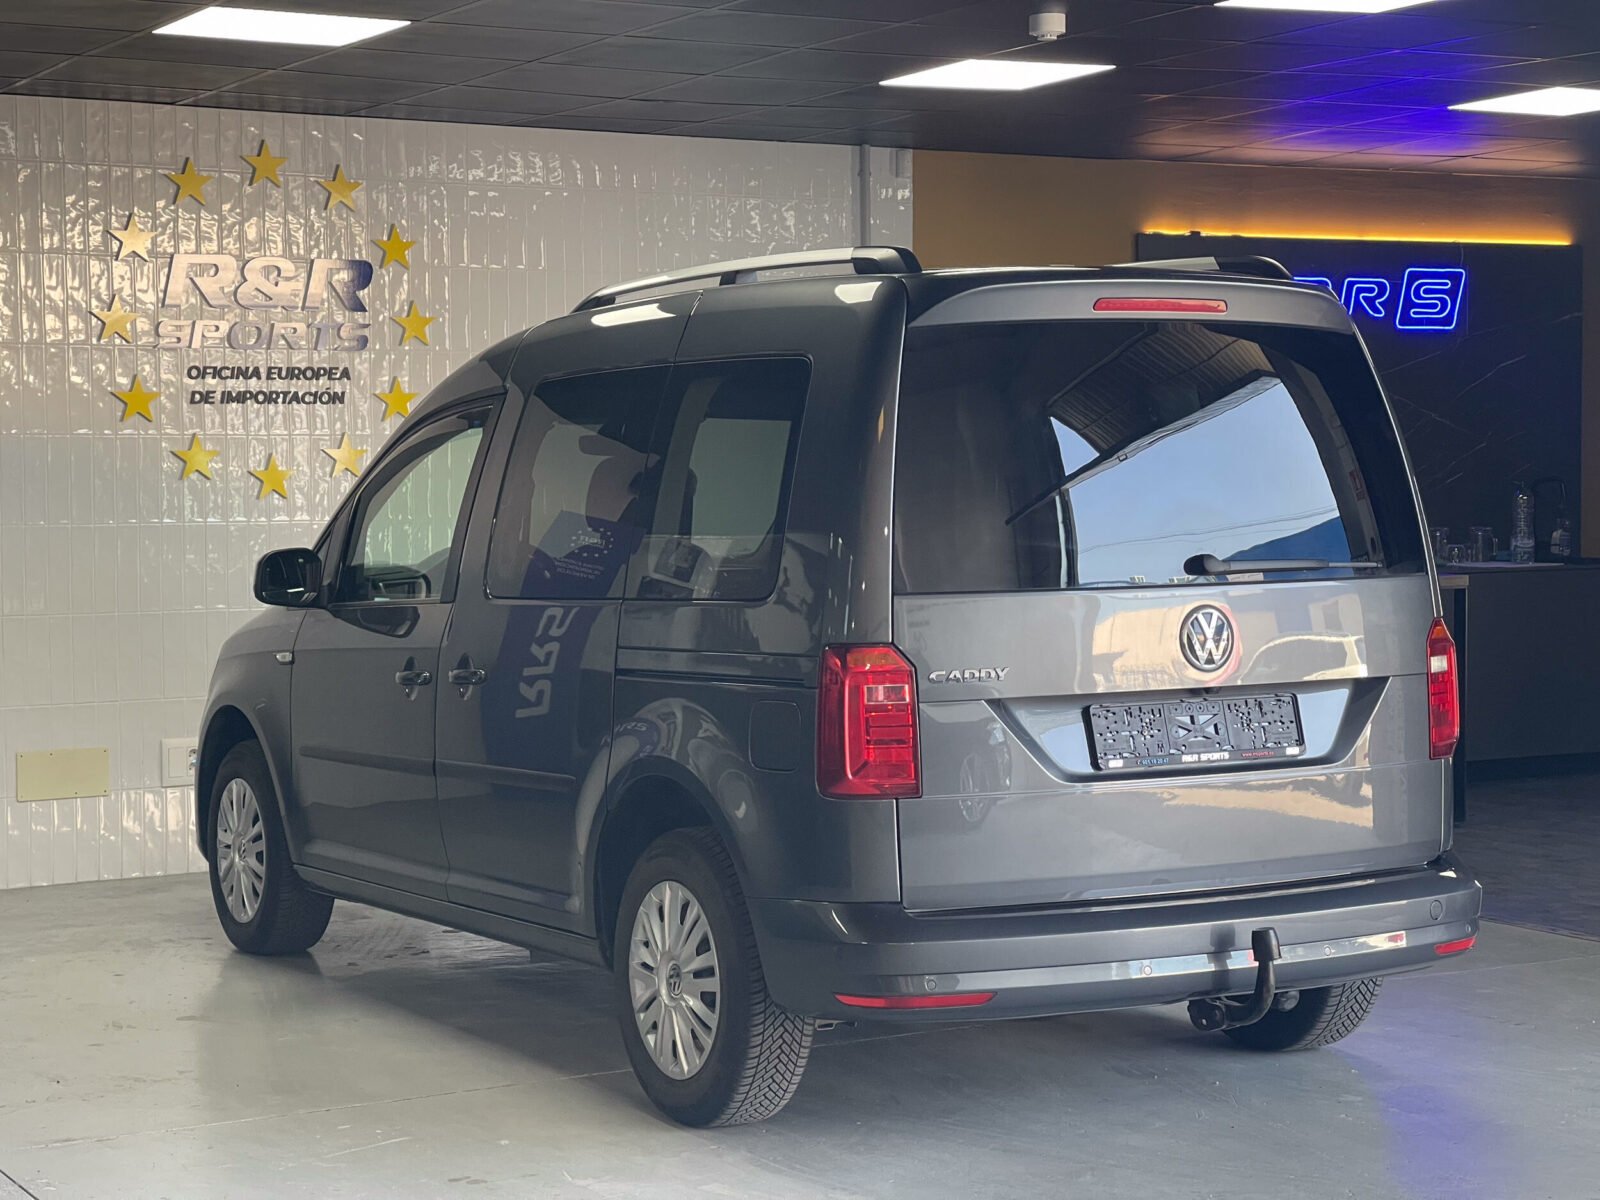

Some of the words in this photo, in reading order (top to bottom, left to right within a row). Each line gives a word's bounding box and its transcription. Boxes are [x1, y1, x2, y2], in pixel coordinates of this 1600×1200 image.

[161, 253, 374, 313] R&R
[1293, 274, 1458, 322] RS
[153, 319, 372, 351] SPORTS
[186, 365, 262, 380] OFICINA
[265, 365, 351, 381] EUROPEA
[189, 390, 215, 405] DE
[219, 387, 346, 405] IMPORTACIÓN
[927, 666, 1010, 684] CADDY
[1200, 751, 1230, 761] SPORTS
